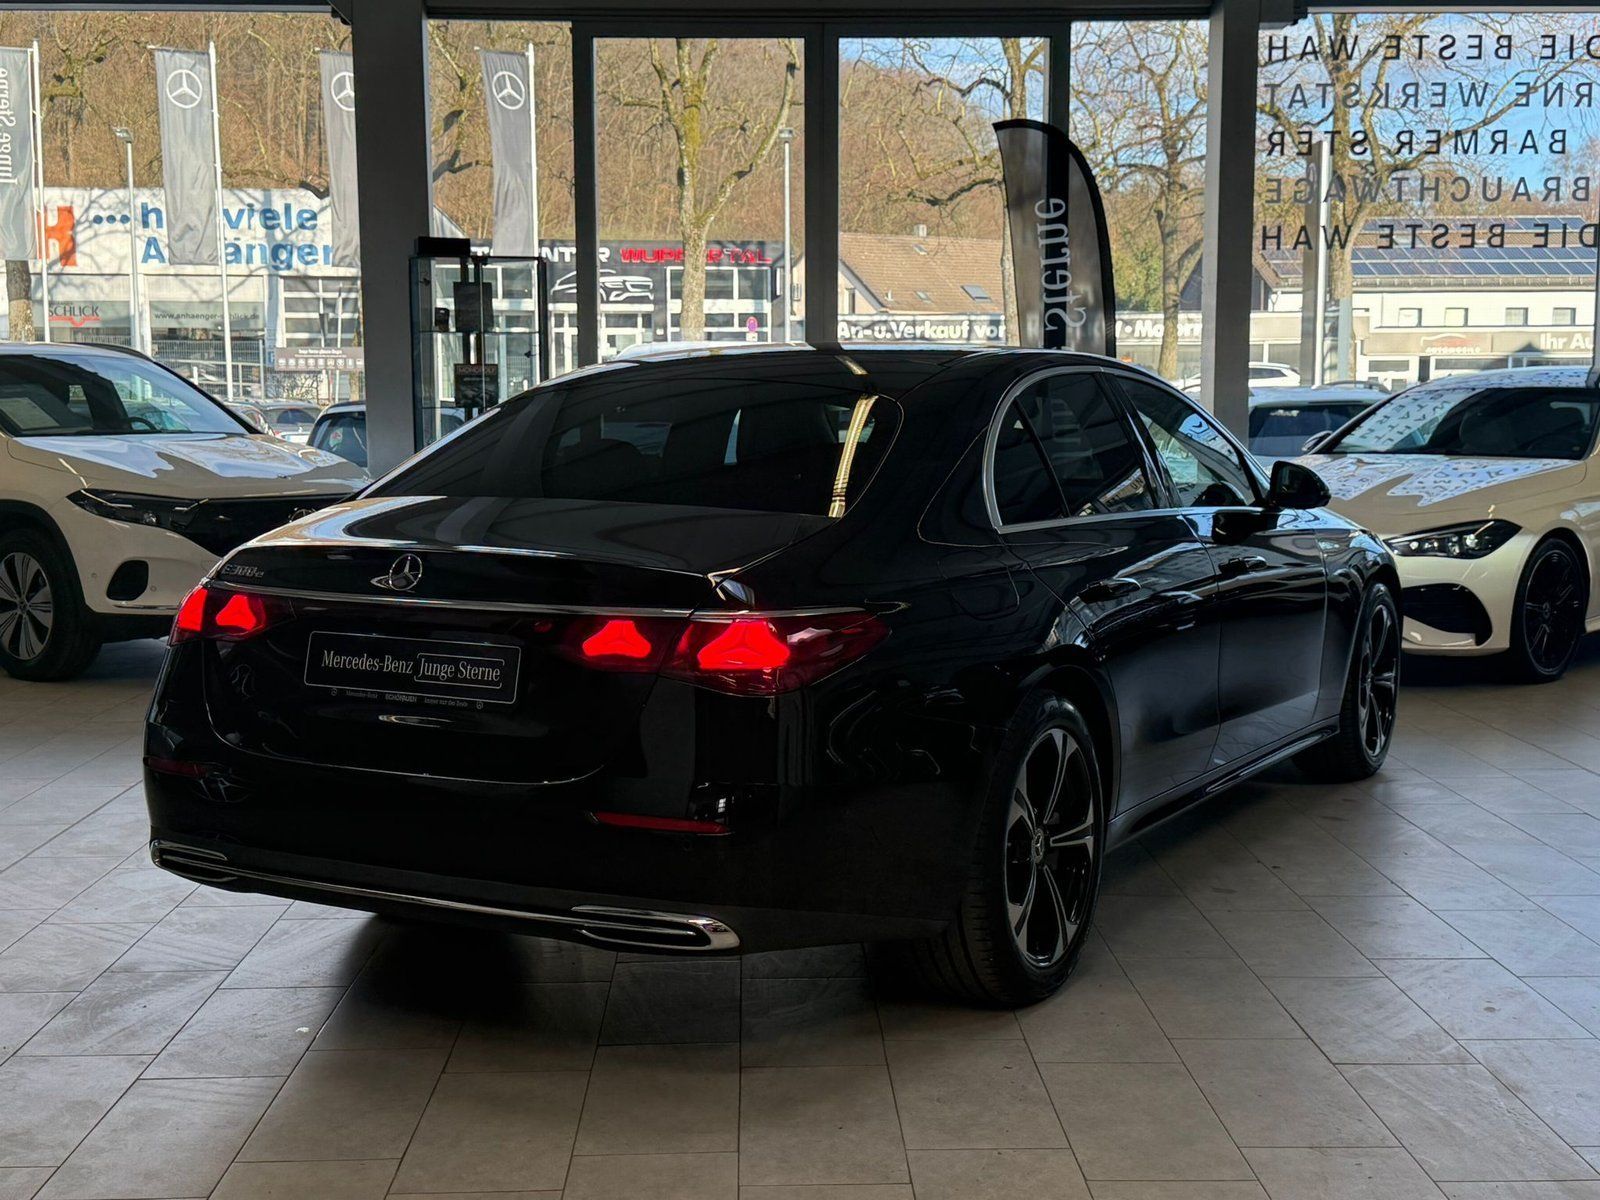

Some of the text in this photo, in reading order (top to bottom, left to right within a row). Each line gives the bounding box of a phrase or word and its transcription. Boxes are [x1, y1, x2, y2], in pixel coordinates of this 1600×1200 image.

[223, 202, 318, 230] viele
[620, 247, 773, 264] WUPPRTAL
[1540, 332, 1569, 350] Ihr
[321, 650, 501, 682] Mercedes-Benz Junge Sterne
